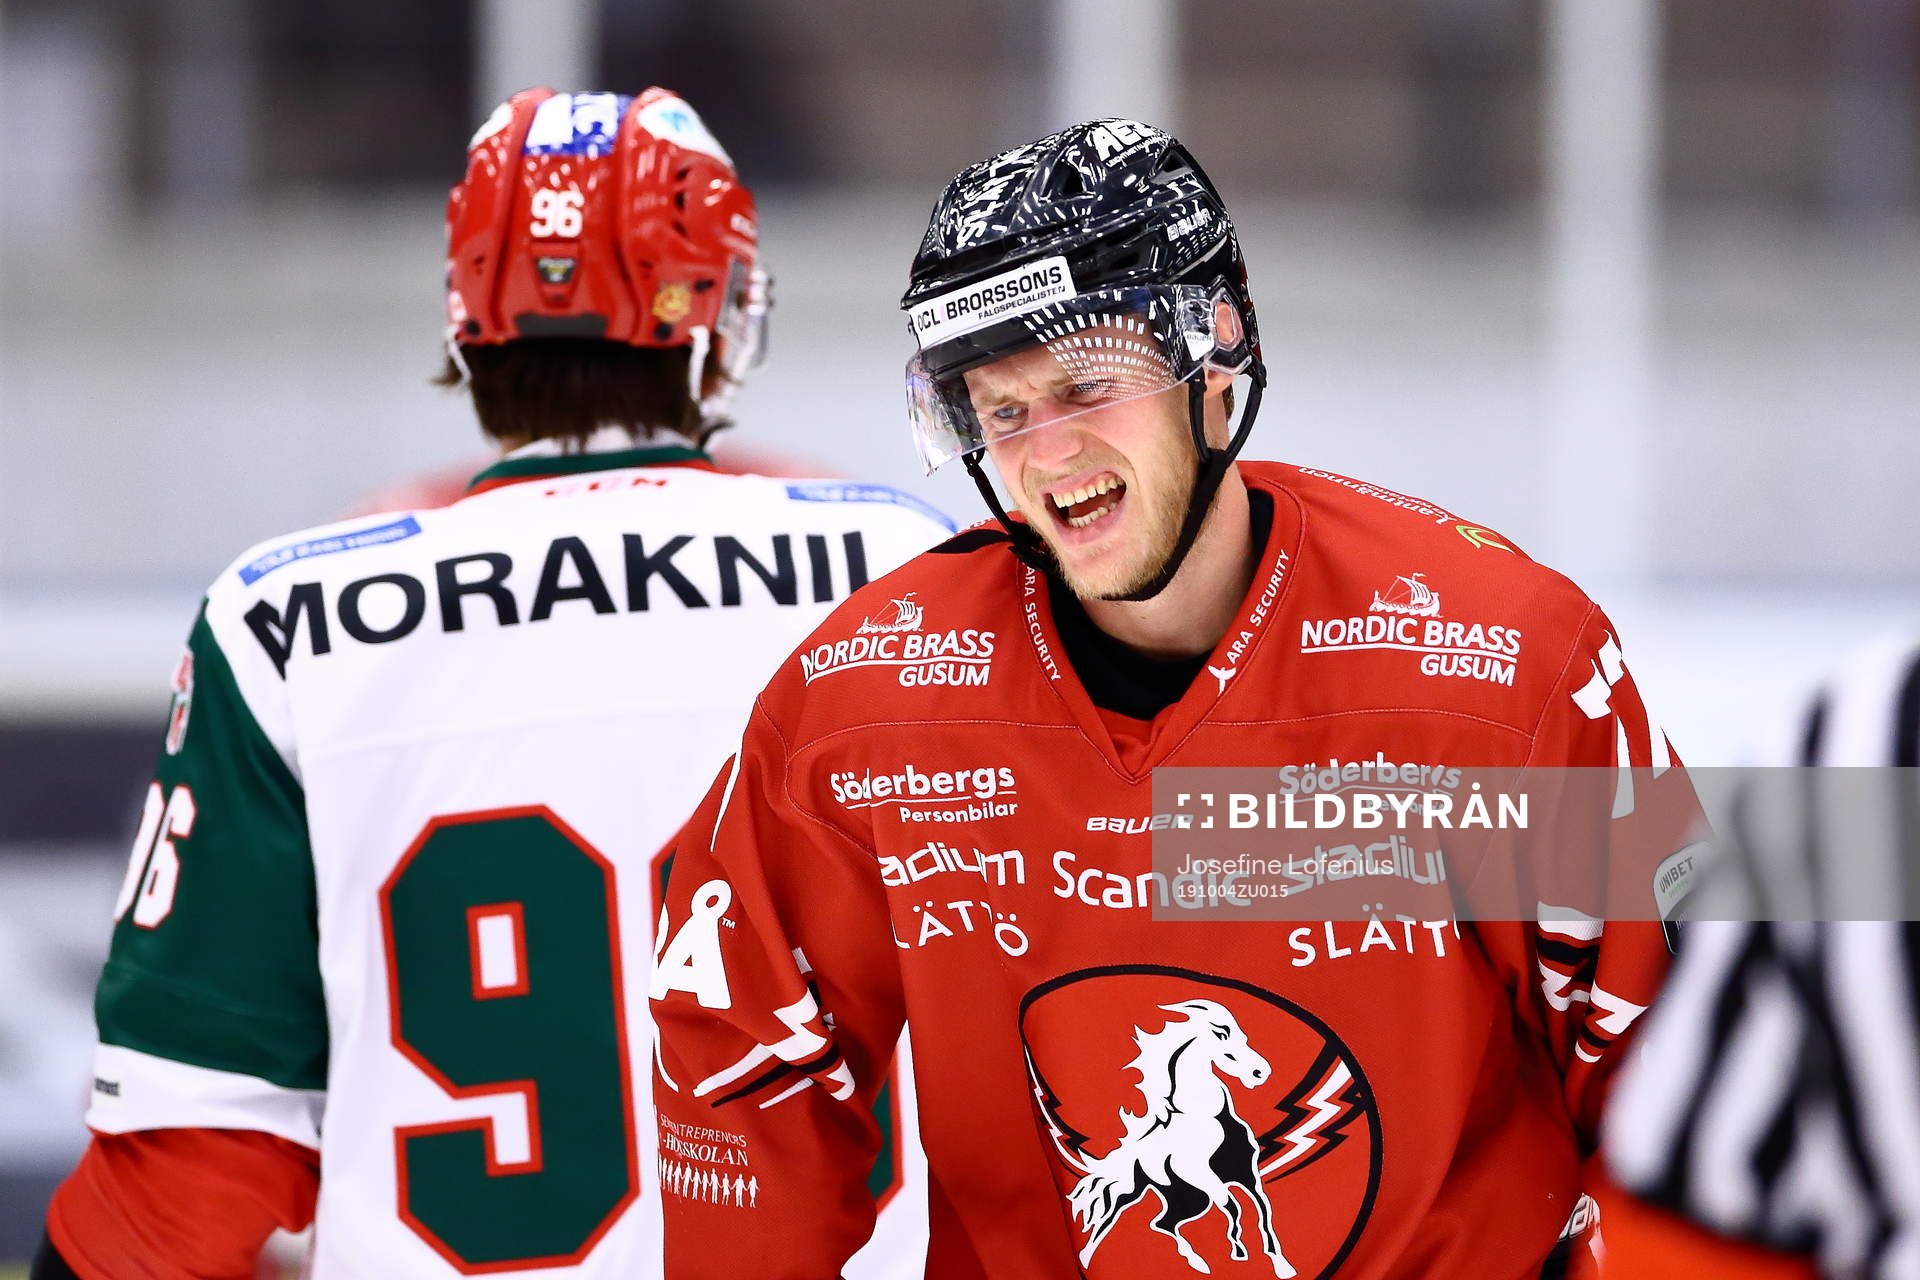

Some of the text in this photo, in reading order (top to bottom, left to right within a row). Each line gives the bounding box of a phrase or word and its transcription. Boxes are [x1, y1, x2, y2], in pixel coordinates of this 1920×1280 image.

[530, 188, 584, 237] 96
[946, 266, 1063, 319] BRORSSONS
[1226, 548, 1290, 664] ARA SECURITY
[799, 629, 996, 680] NORDIC BRASS
[1024, 602, 1062, 681] SECURITY
[1300, 615, 1522, 656] NORDIC BRASS
[898, 663, 990, 688] GUSUM
[1420, 654, 1516, 687] GUSUM
[830, 765, 1017, 803] Söderbergs
[899, 801, 1018, 823] Personbilar
[1052, 850, 1252, 910] Scandic
[1658, 856, 1694, 893] UNIBET
[1287, 903, 1462, 967] SLÄTT
[377, 803, 690, 1276] 9
